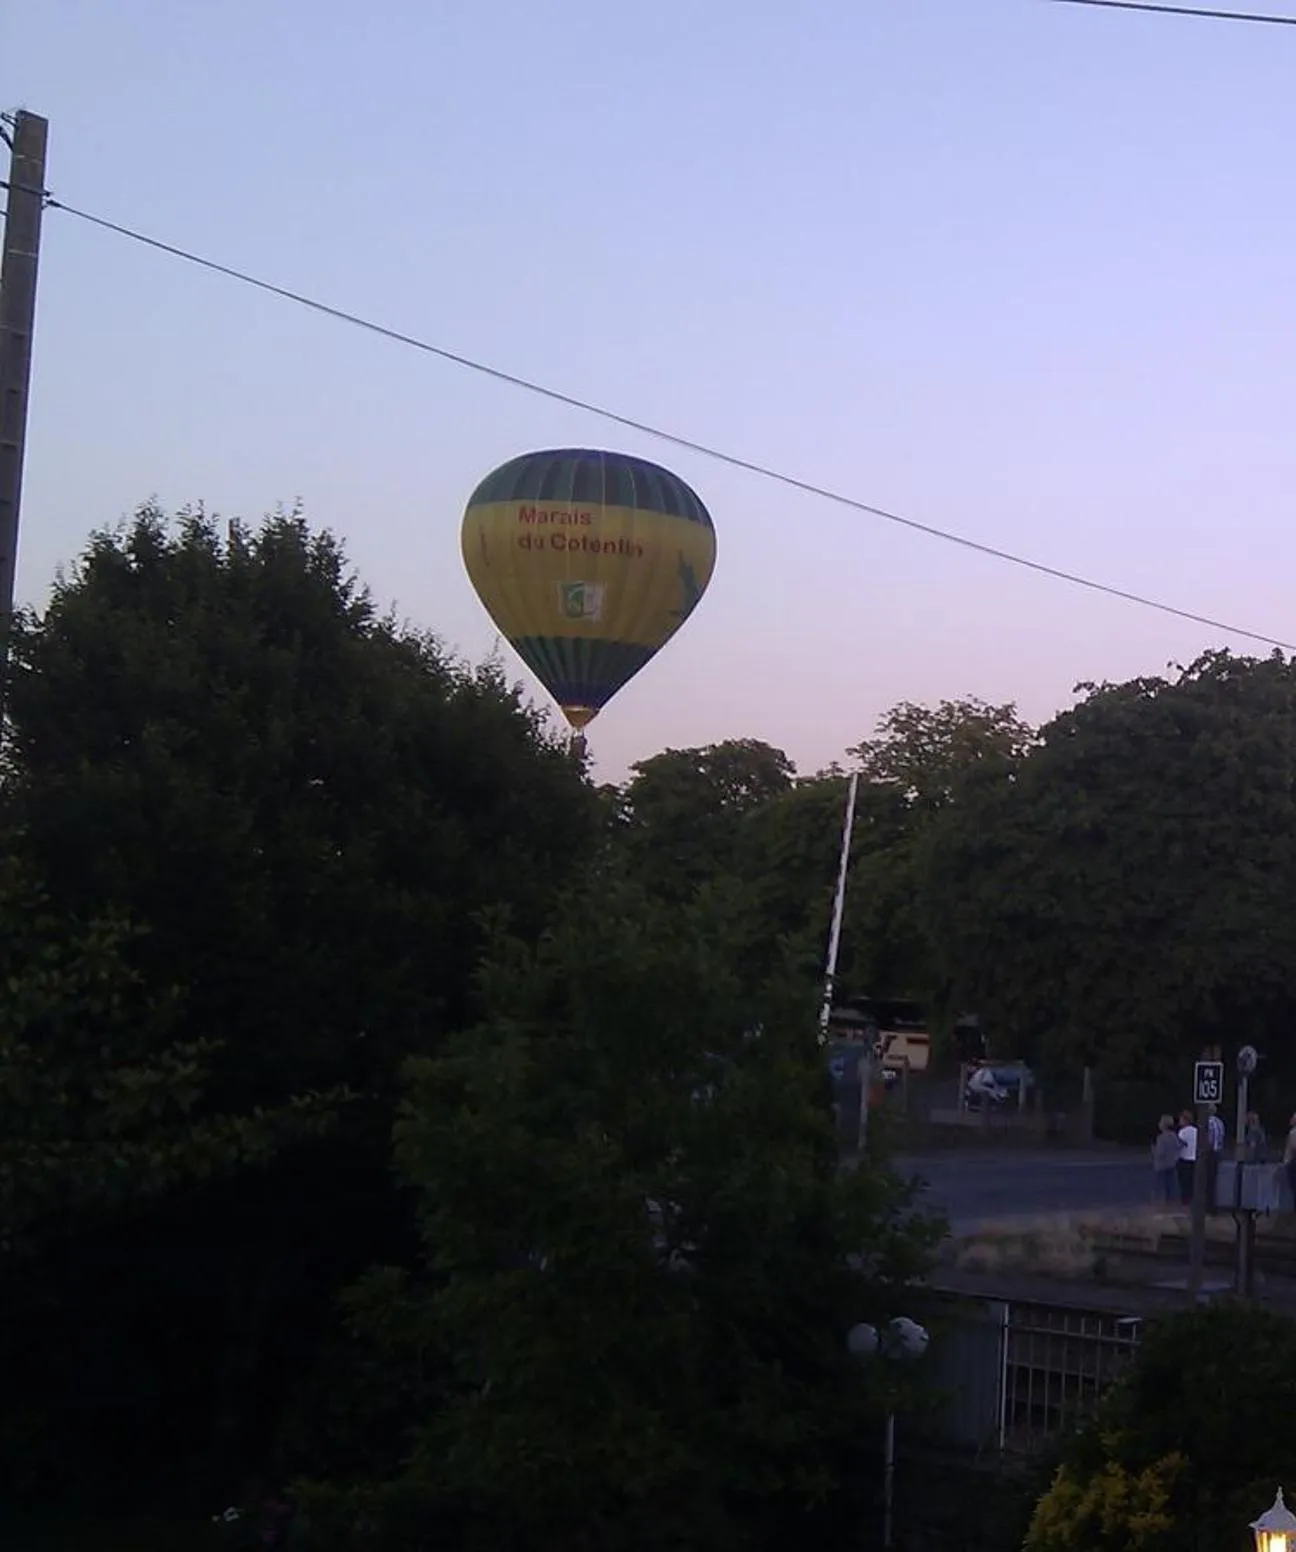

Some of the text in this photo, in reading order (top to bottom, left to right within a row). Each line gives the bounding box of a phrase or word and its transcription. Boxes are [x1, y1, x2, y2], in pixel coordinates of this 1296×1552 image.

[518, 505, 593, 526] Marais
[518, 532, 645, 559] du Cotentin
[1199, 1079, 1218, 1098] 105
